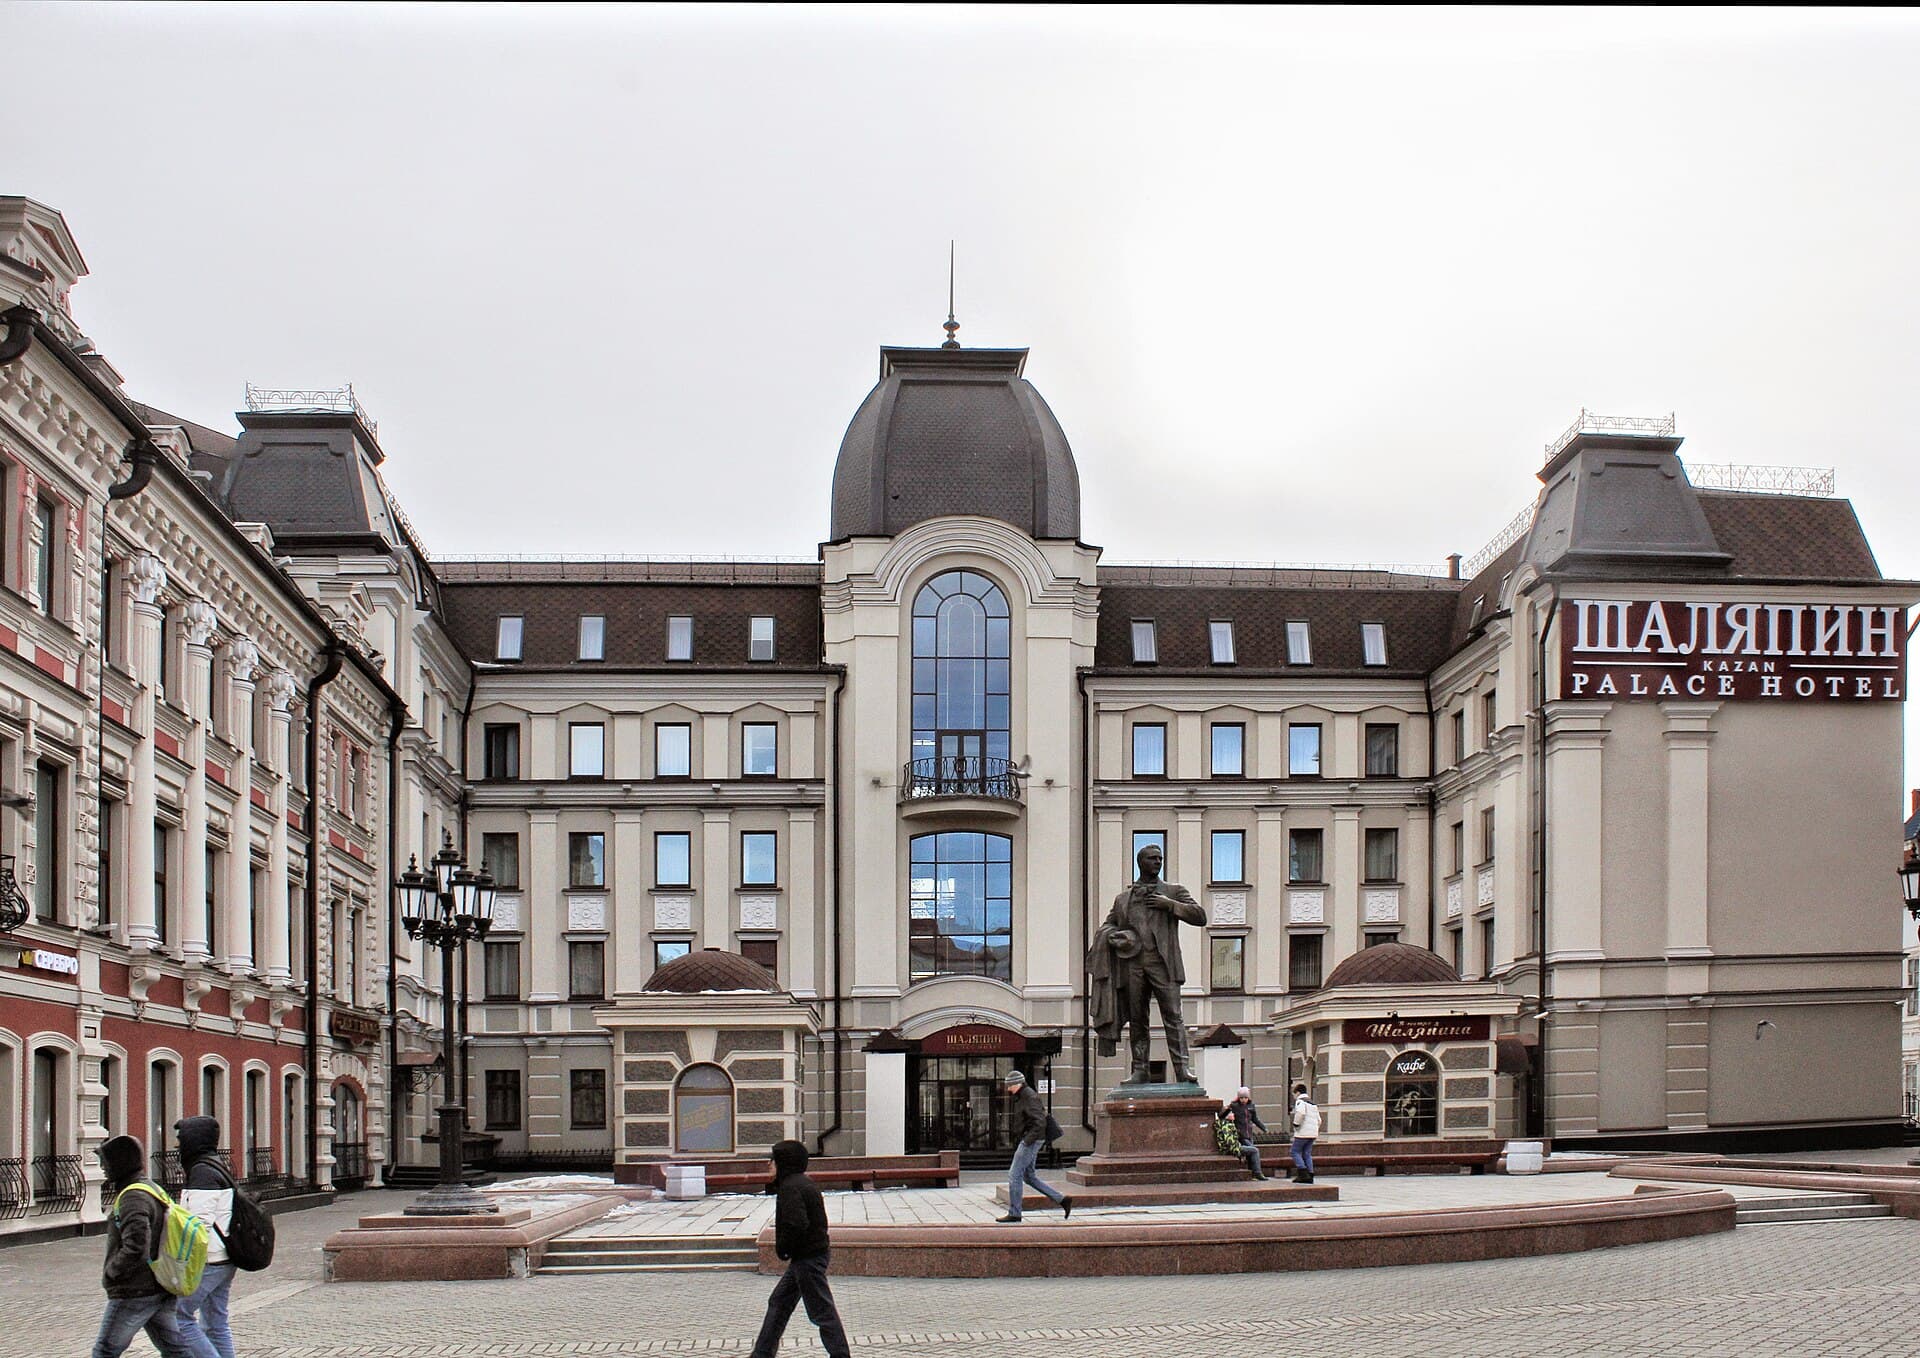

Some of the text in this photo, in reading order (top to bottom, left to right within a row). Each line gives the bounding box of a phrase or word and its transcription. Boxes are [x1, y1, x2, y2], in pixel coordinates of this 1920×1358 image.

[1573, 600, 1900, 657] ШАЛЯПИН
[1703, 660, 1776, 673] KAZAN
[1572, 673, 1900, 698] PALACE HOTEL
[35, 949, 78, 975] СЕРЕБРО
[946, 1034, 1002, 1044] ШАЛЯПИН
[1365, 1023, 1472, 1039] Шаляпина
[1397, 1058, 1426, 1074] кафе
